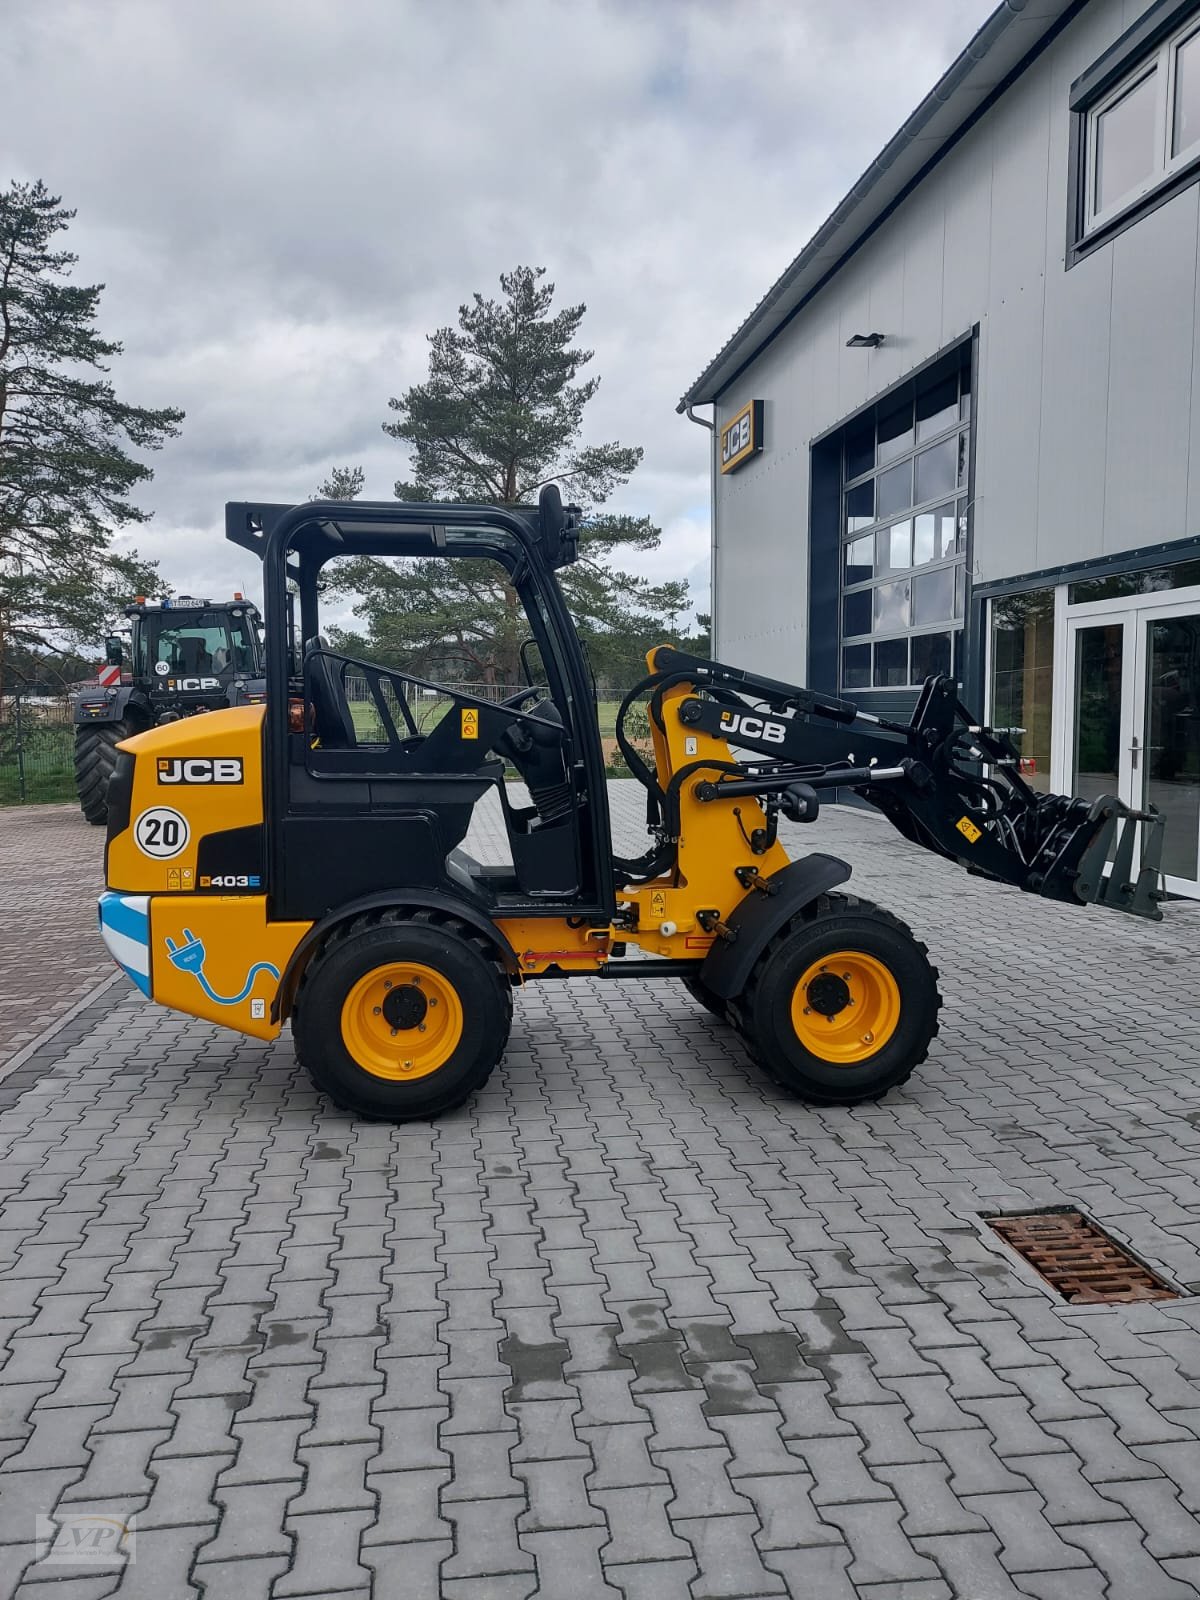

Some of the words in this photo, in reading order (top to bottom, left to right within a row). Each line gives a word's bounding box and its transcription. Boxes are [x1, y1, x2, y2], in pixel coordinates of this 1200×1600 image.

[723, 414, 750, 462] JCB
[719, 713, 786, 743] JCB
[159, 760, 242, 783] JCB
[145, 819, 179, 846] 20
[210, 875, 261, 887] 403E
